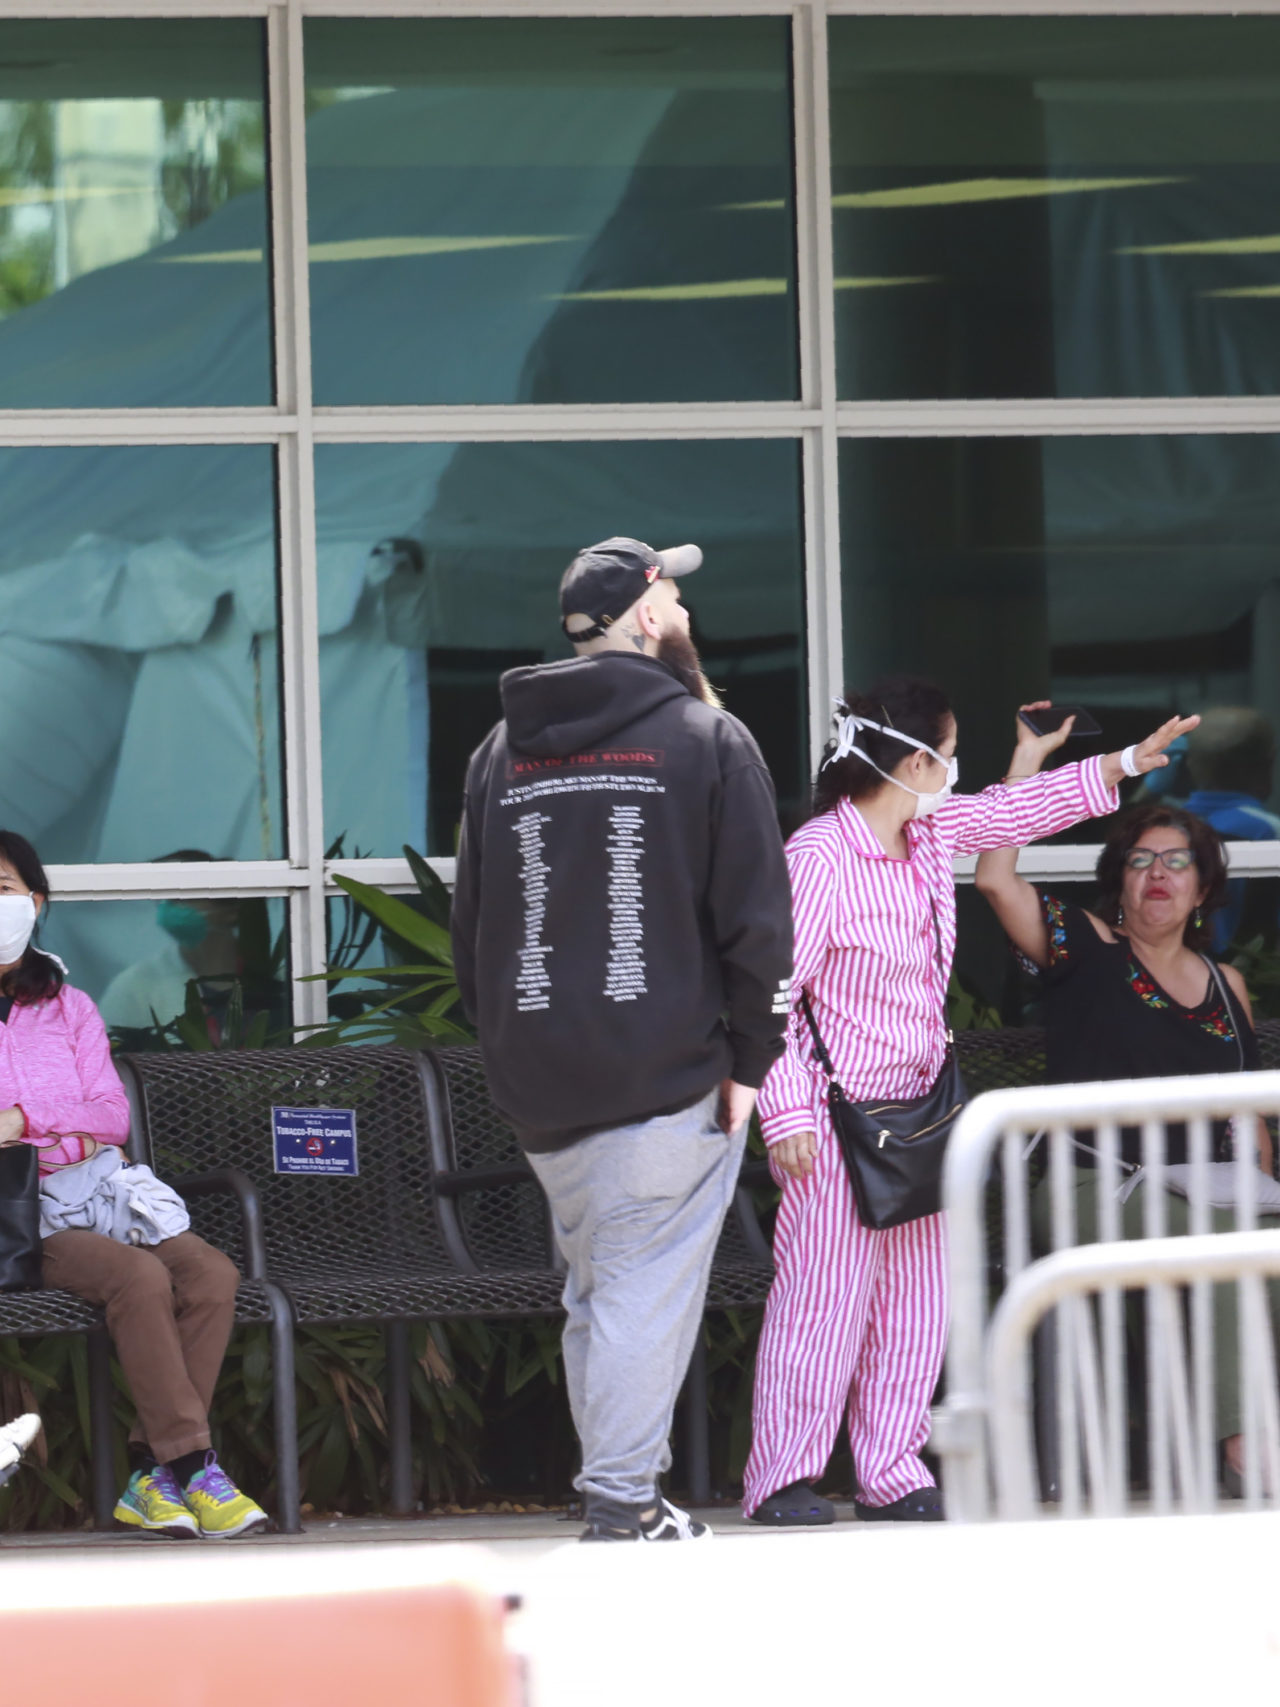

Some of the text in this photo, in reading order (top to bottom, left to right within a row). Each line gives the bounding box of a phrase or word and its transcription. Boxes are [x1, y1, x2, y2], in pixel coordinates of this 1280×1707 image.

[514, 761, 543, 773] MAN
[569, 754, 598, 765] THE
[602, 752, 655, 763] WOODS
[276, 1126, 352, 1137] TOBACCO-FREE CAMPUS
